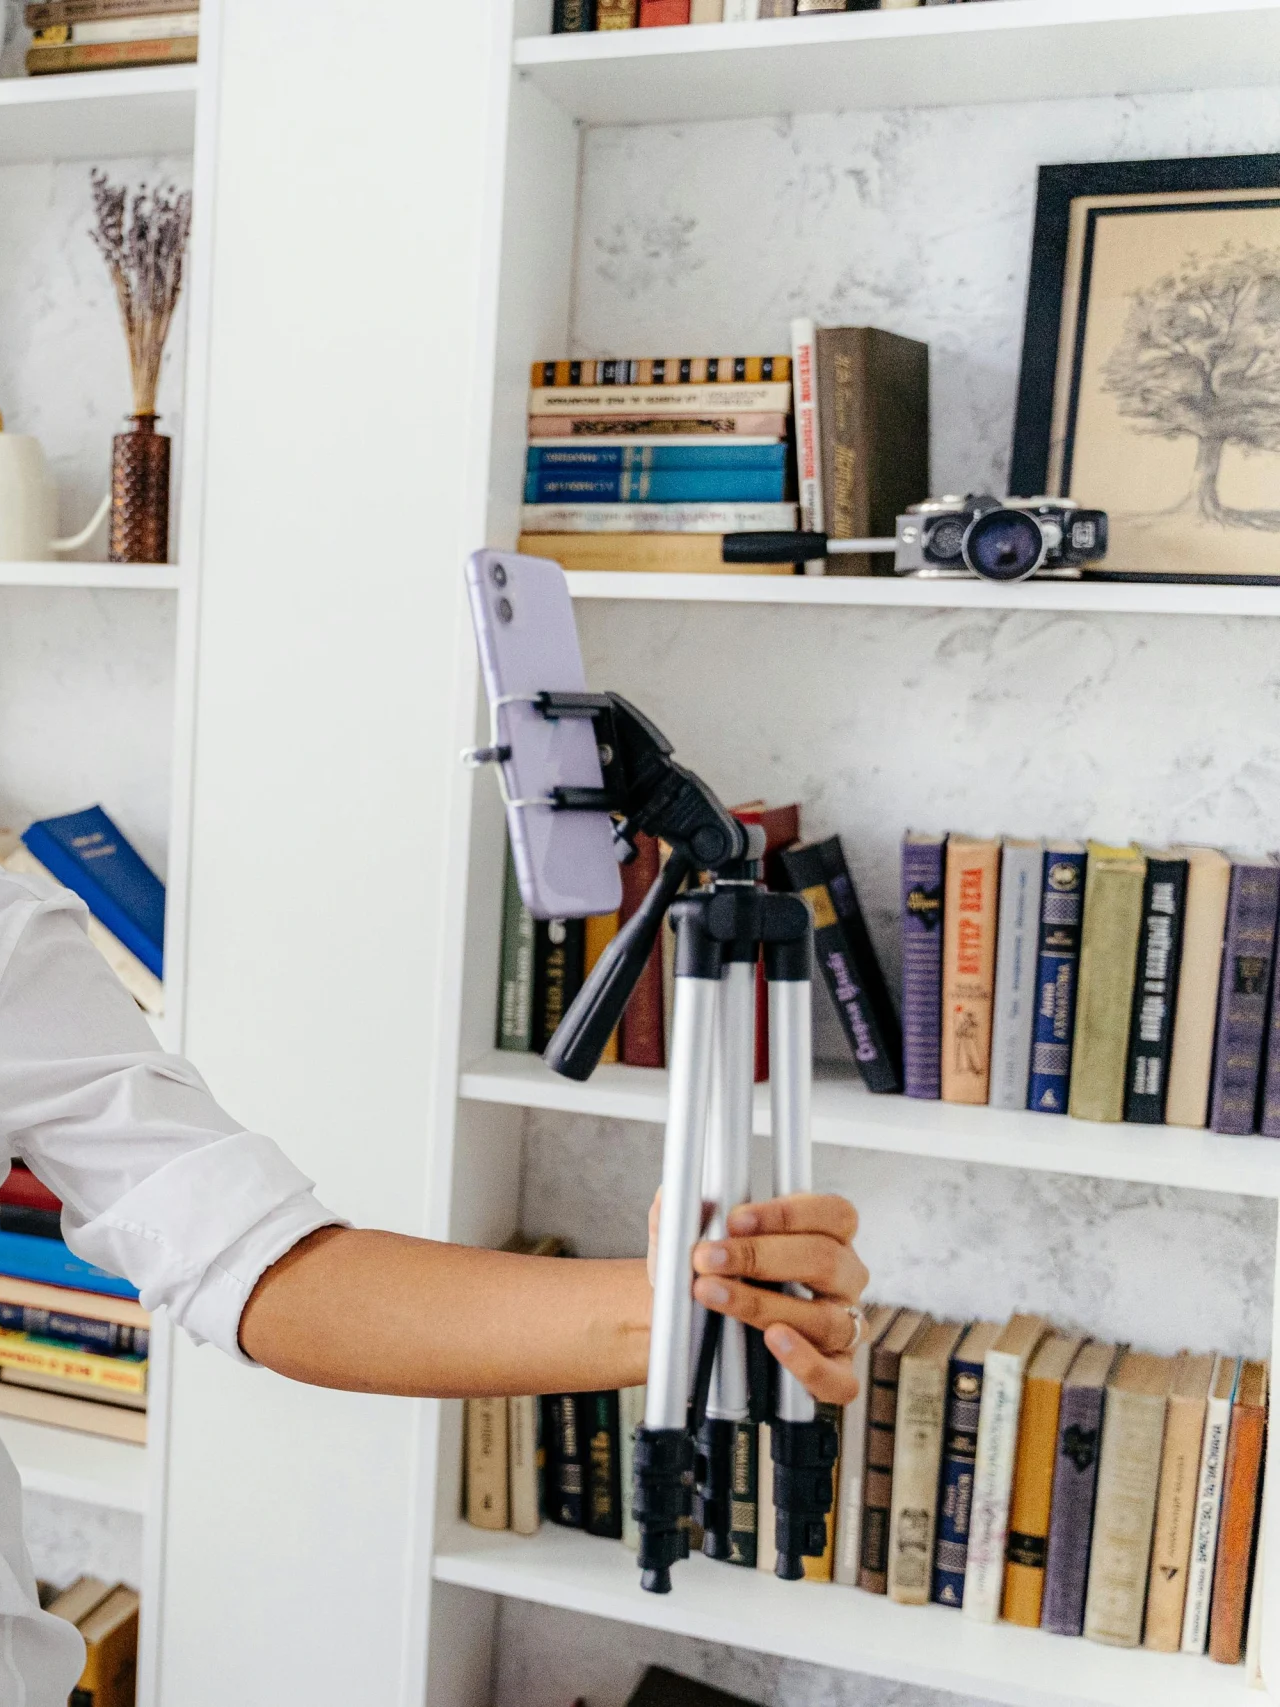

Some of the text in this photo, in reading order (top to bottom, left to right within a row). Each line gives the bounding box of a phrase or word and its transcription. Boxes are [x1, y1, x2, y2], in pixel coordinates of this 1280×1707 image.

[958, 868, 983, 912] ВЕКА
[957, 918, 981, 974] ВЕТЕР
[1053, 963, 1071, 1039] АХМАТОВА
[1197, 1501, 1213, 1564] БРАТСТВО
